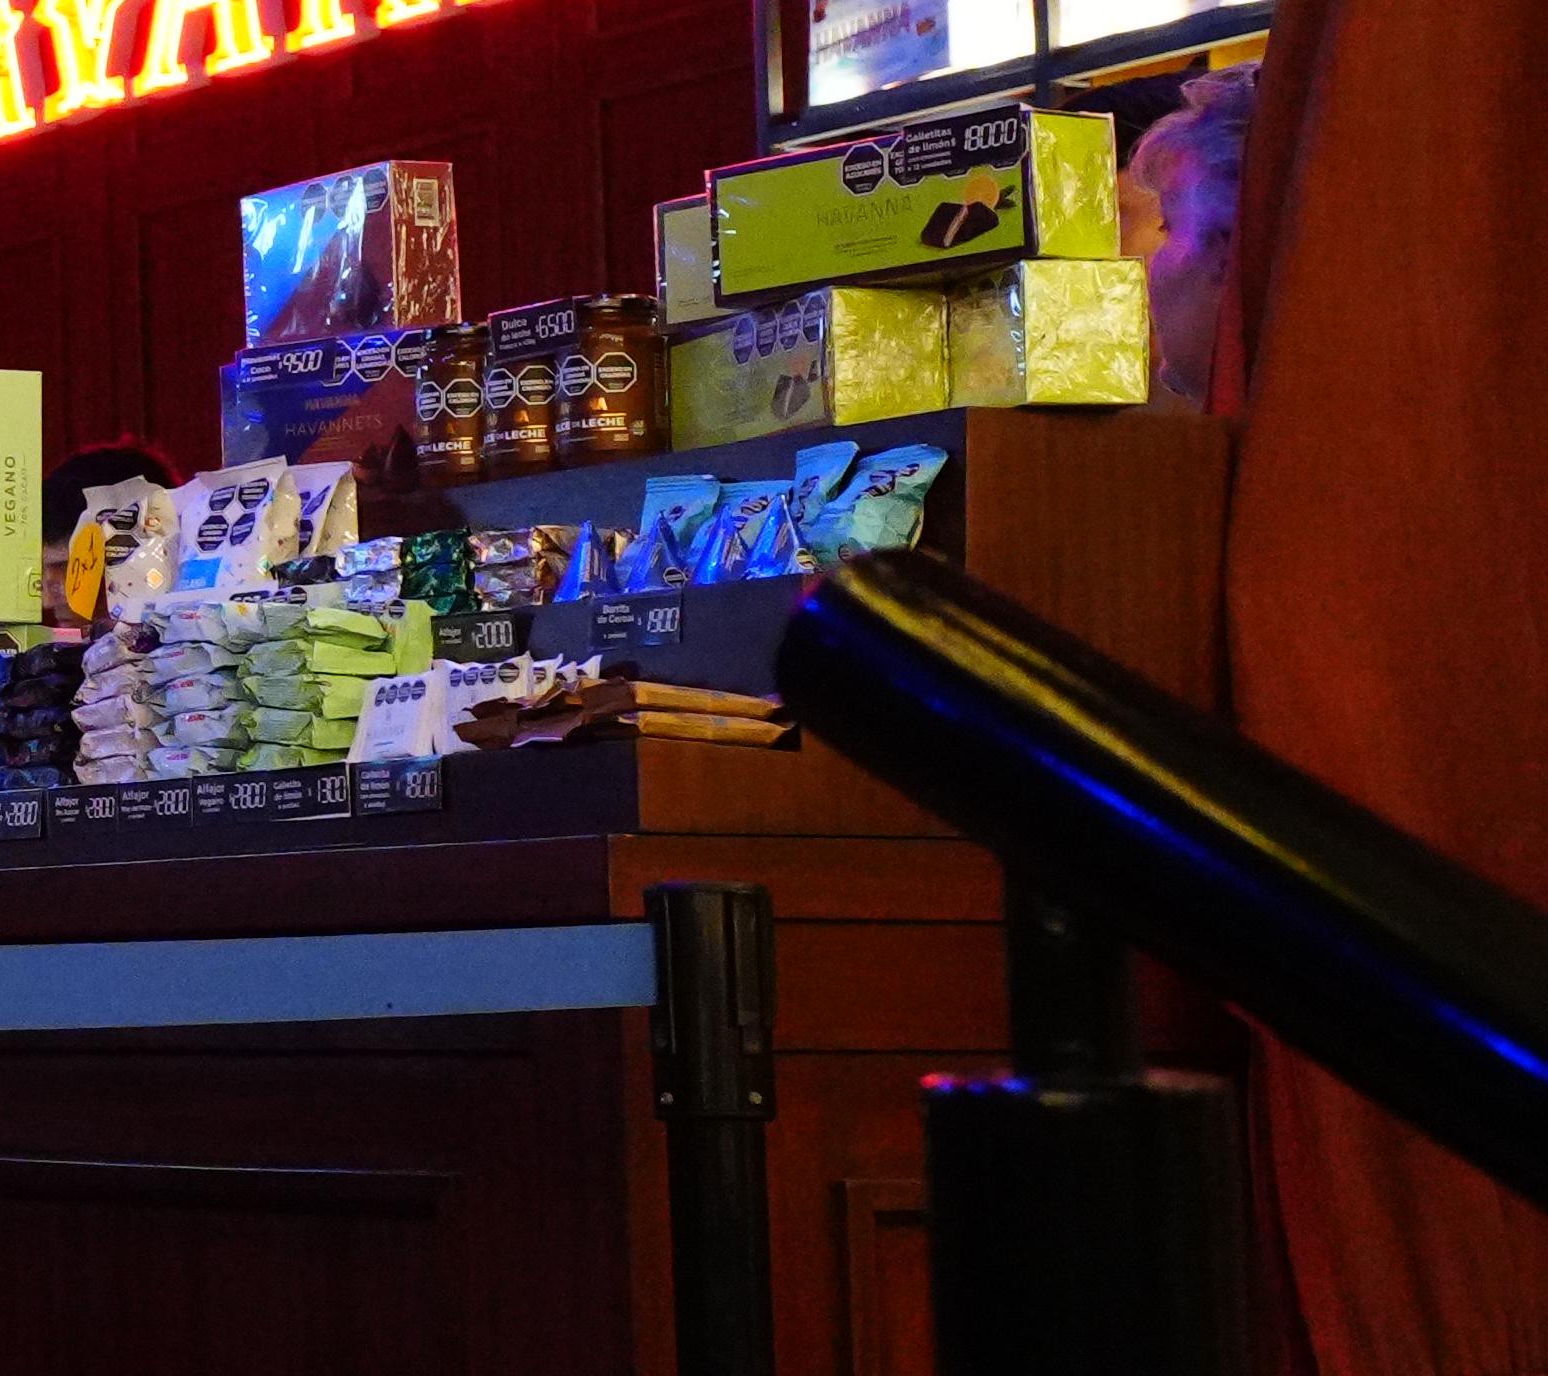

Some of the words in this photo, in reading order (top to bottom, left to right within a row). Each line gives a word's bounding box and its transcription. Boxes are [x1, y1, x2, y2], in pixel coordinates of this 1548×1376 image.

[582, 416, 625, 429] LECHE
[505, 428, 546, 441] LECHE
[432, 440, 471, 453] LECHE
[3, 455, 17, 537] VEGANO
